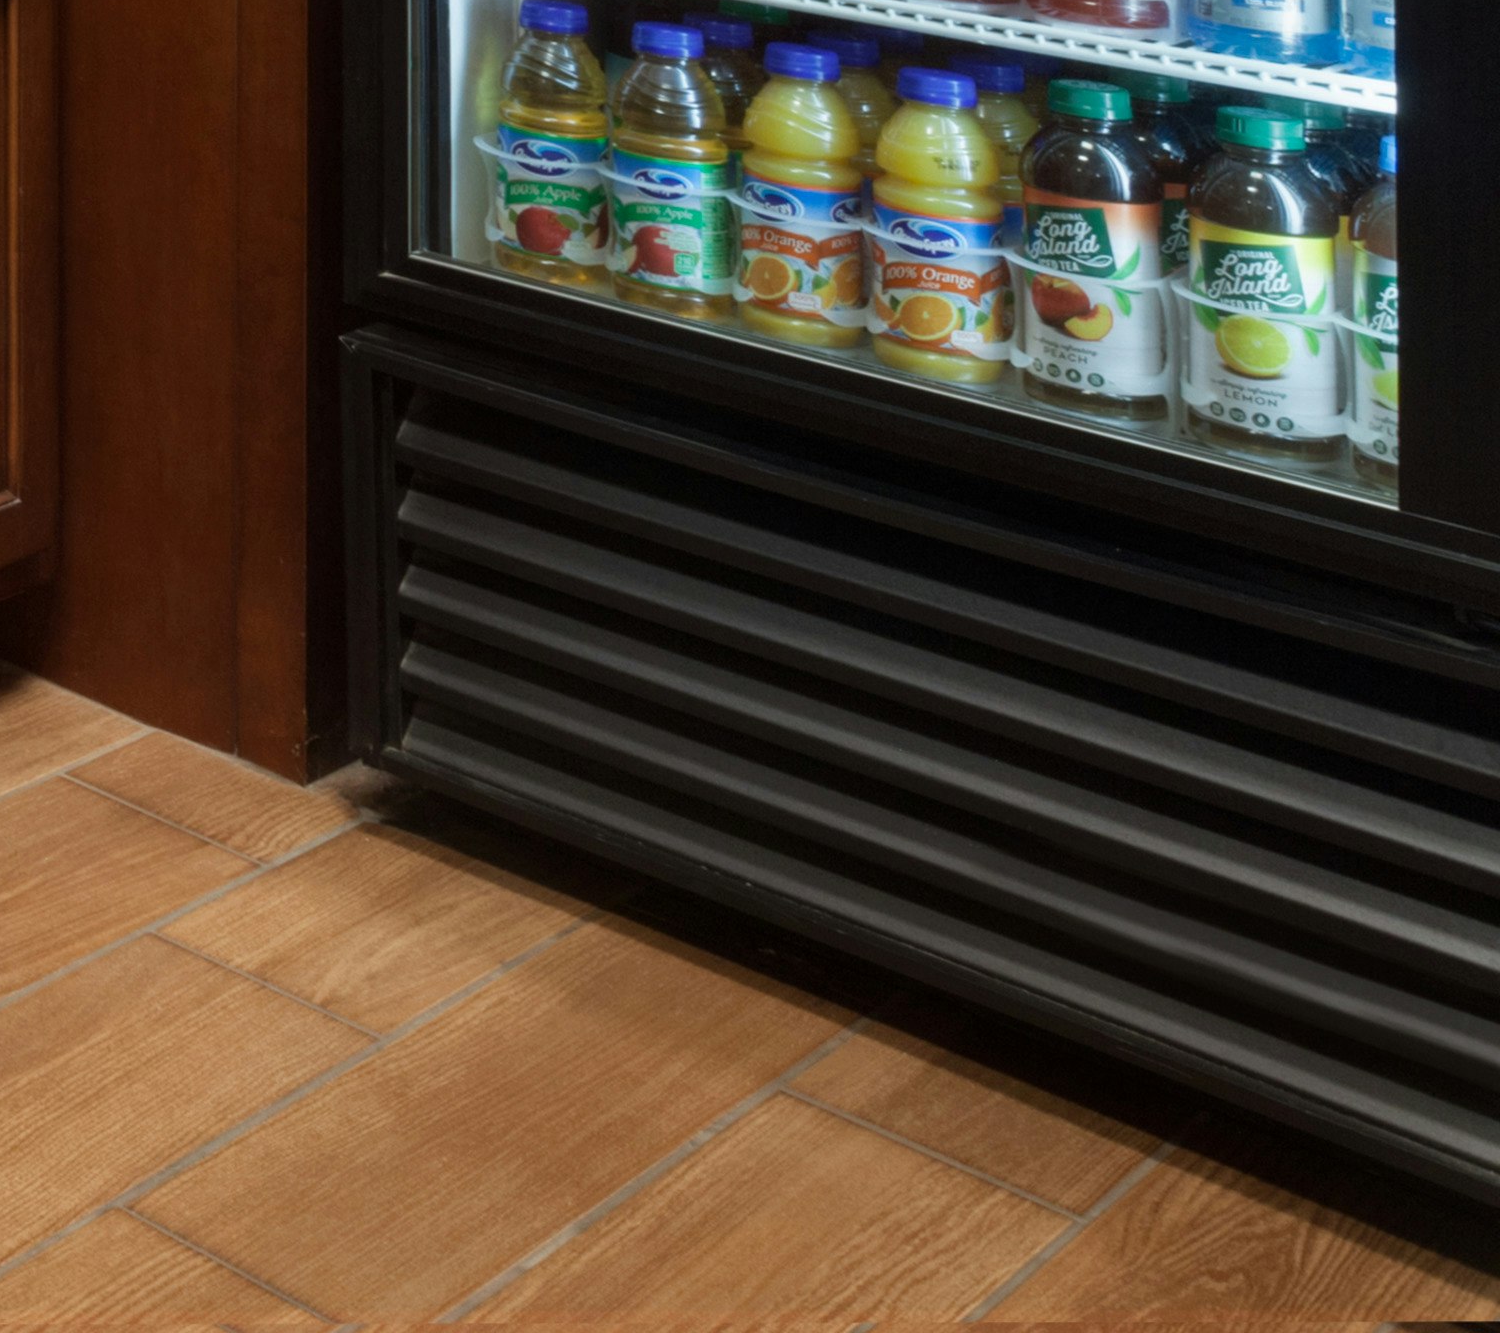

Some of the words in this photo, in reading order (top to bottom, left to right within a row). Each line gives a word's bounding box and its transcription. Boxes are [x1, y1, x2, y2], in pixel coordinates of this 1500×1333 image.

[510, 183, 541, 198] 100%
[543, 185, 582, 203] Apple
[922, 267, 976, 290] Orange
[1215, 255, 1281, 281] Long
[1208, 271, 1291, 298] Island
[1043, 345, 1088, 365] PEACH
[1223, 388, 1278, 408] LEMON
